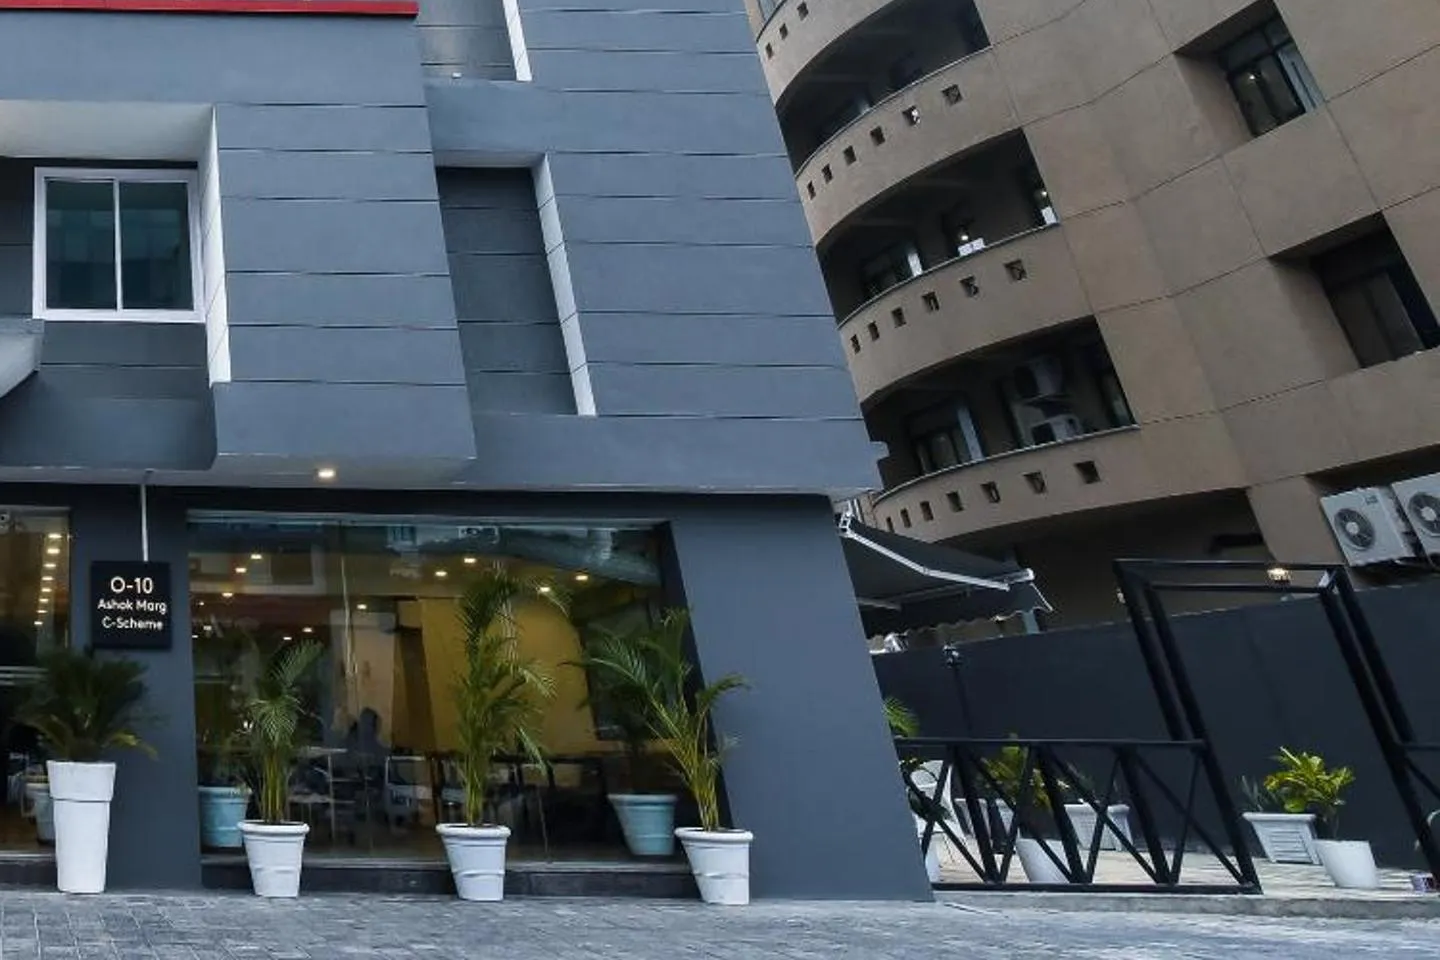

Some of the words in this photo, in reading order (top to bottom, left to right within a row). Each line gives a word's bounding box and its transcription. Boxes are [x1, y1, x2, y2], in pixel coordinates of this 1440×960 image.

[98, 599, 133, 611] Ashok
[135, 600, 167, 615] Marg
[101, 616, 164, 630] C-Scheme
